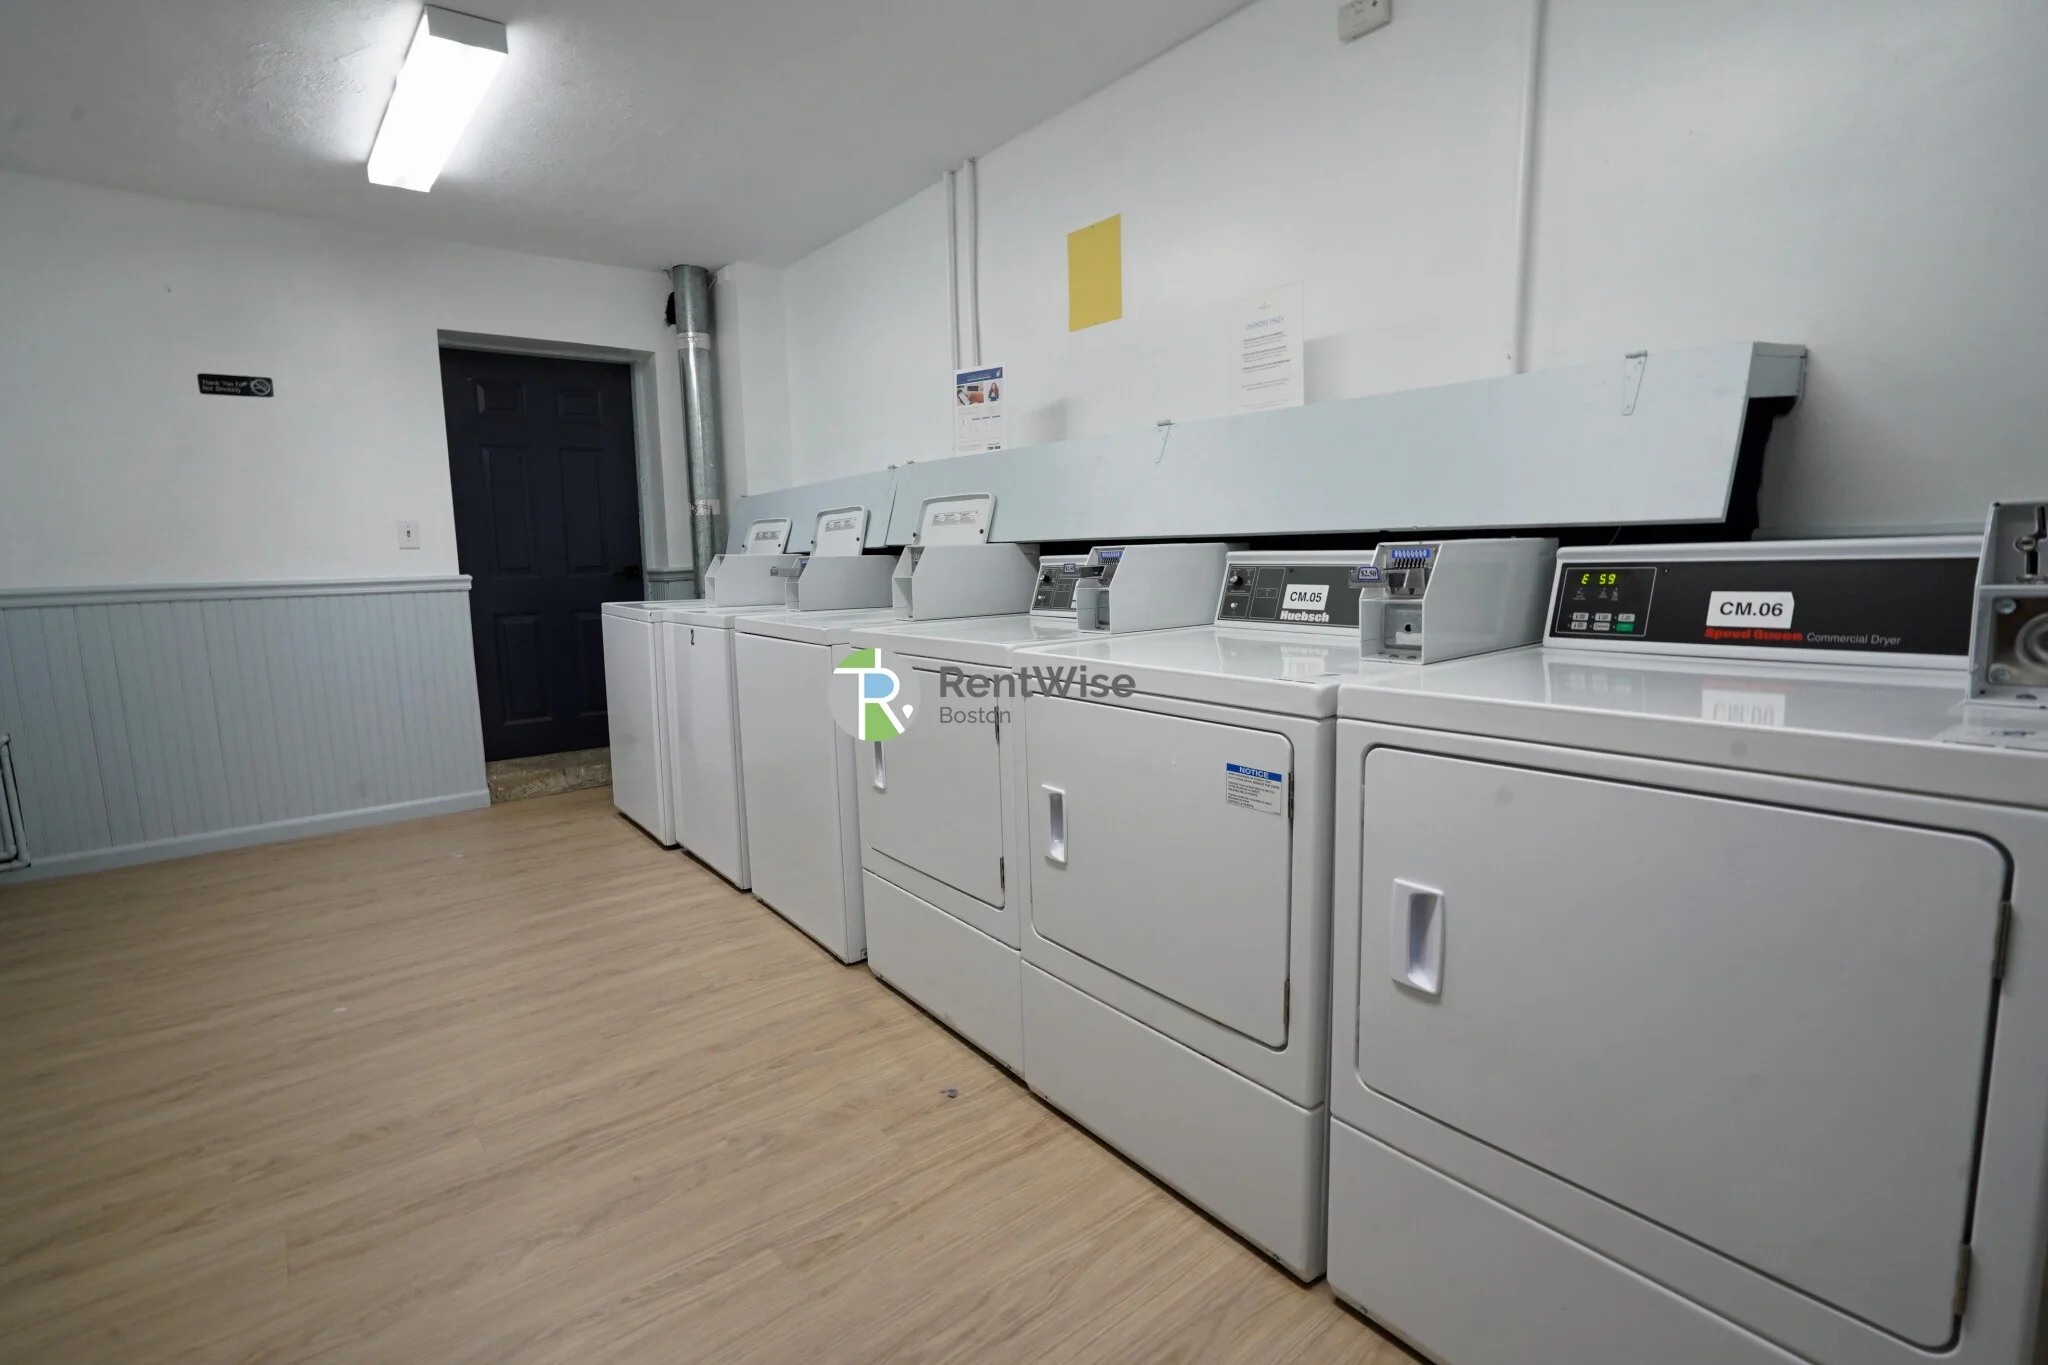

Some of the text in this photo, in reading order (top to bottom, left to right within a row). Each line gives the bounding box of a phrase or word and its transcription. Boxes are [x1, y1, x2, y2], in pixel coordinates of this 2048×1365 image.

[1360, 569, 1377, 577] $2.50
[1581, 573, 1590, 585] E
[1290, 591, 1323, 603] CM.05
[1719, 601, 1784, 617] CM.06
[1280, 610, 1330, 623] Huebsch
[1704, 627, 1804, 641] Speed Queen
[1806, 632, 1901, 647] Commercial Dryer
[1239, 766, 1269, 779] NOTICE
